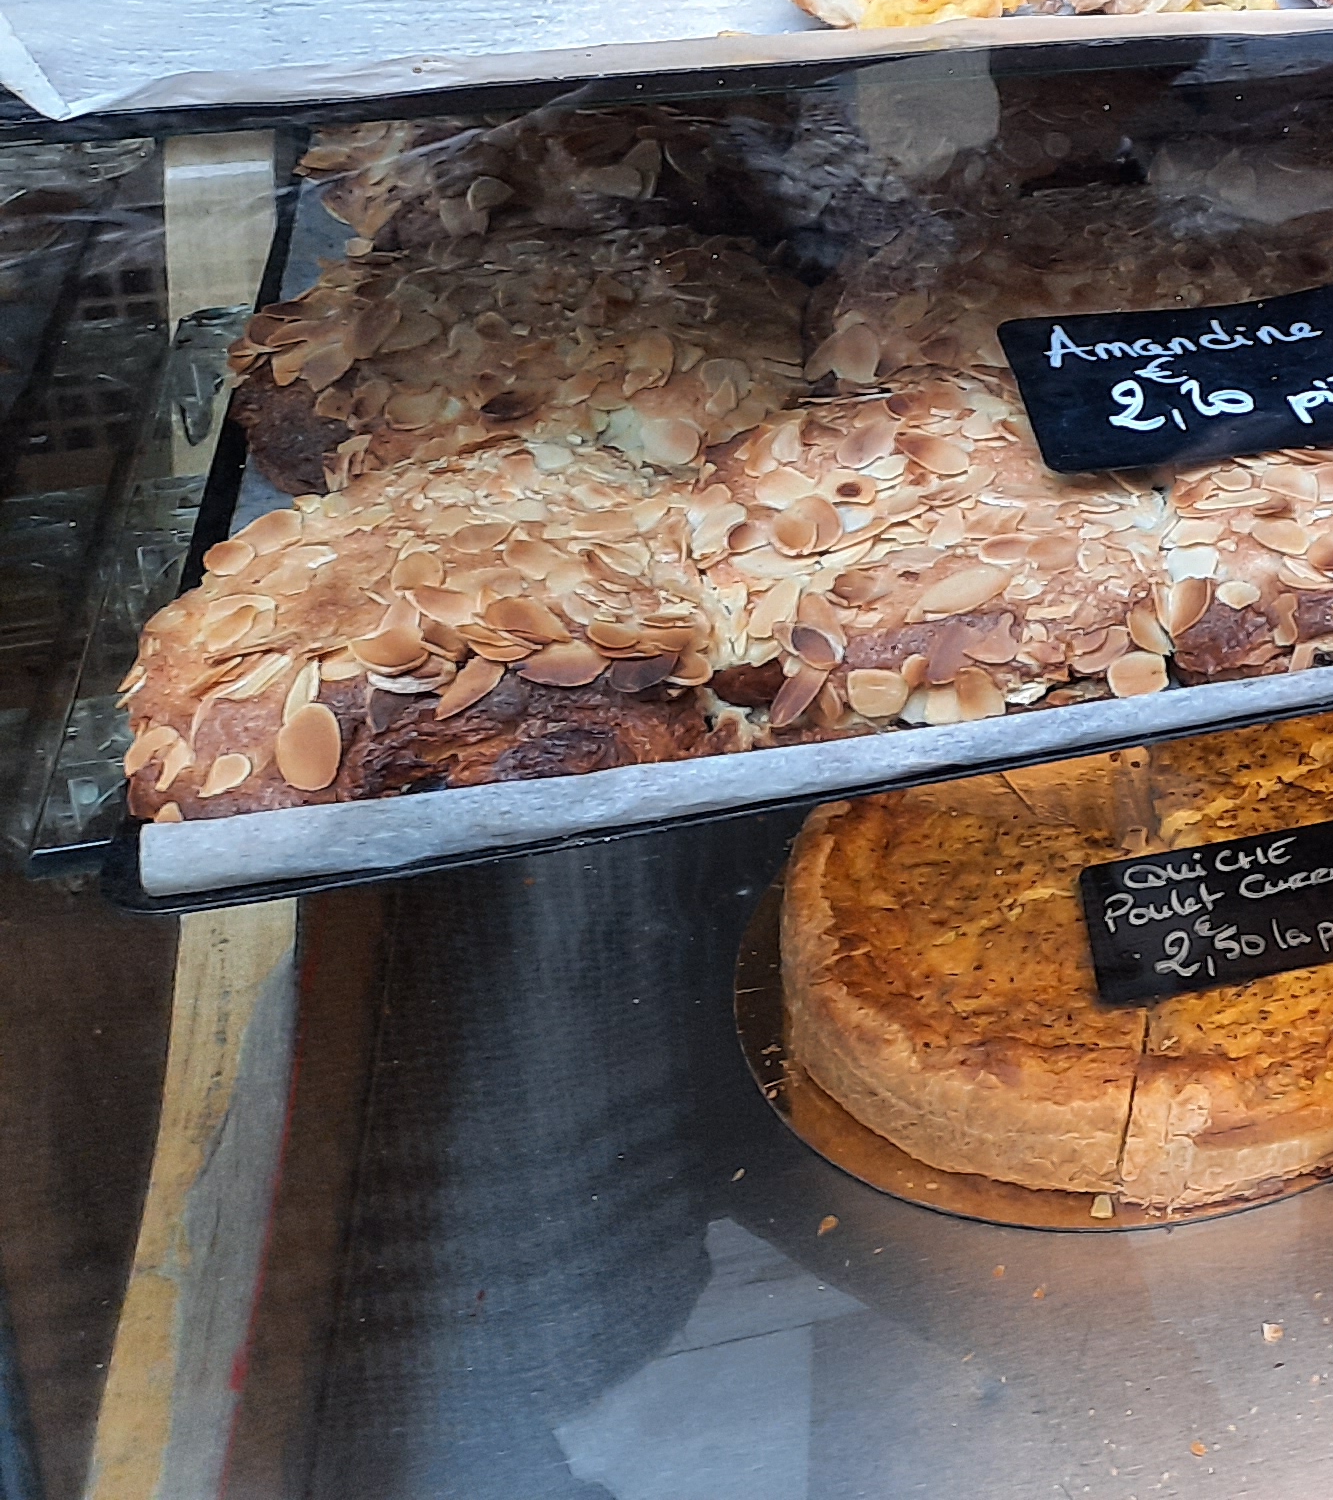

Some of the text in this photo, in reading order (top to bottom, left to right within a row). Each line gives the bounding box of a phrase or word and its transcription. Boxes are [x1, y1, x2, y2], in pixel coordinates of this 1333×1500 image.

[1043, 319, 1324, 369] Amandine
[1103, 881, 1226, 934] Poulet
[1271, 917, 1313, 950] la
